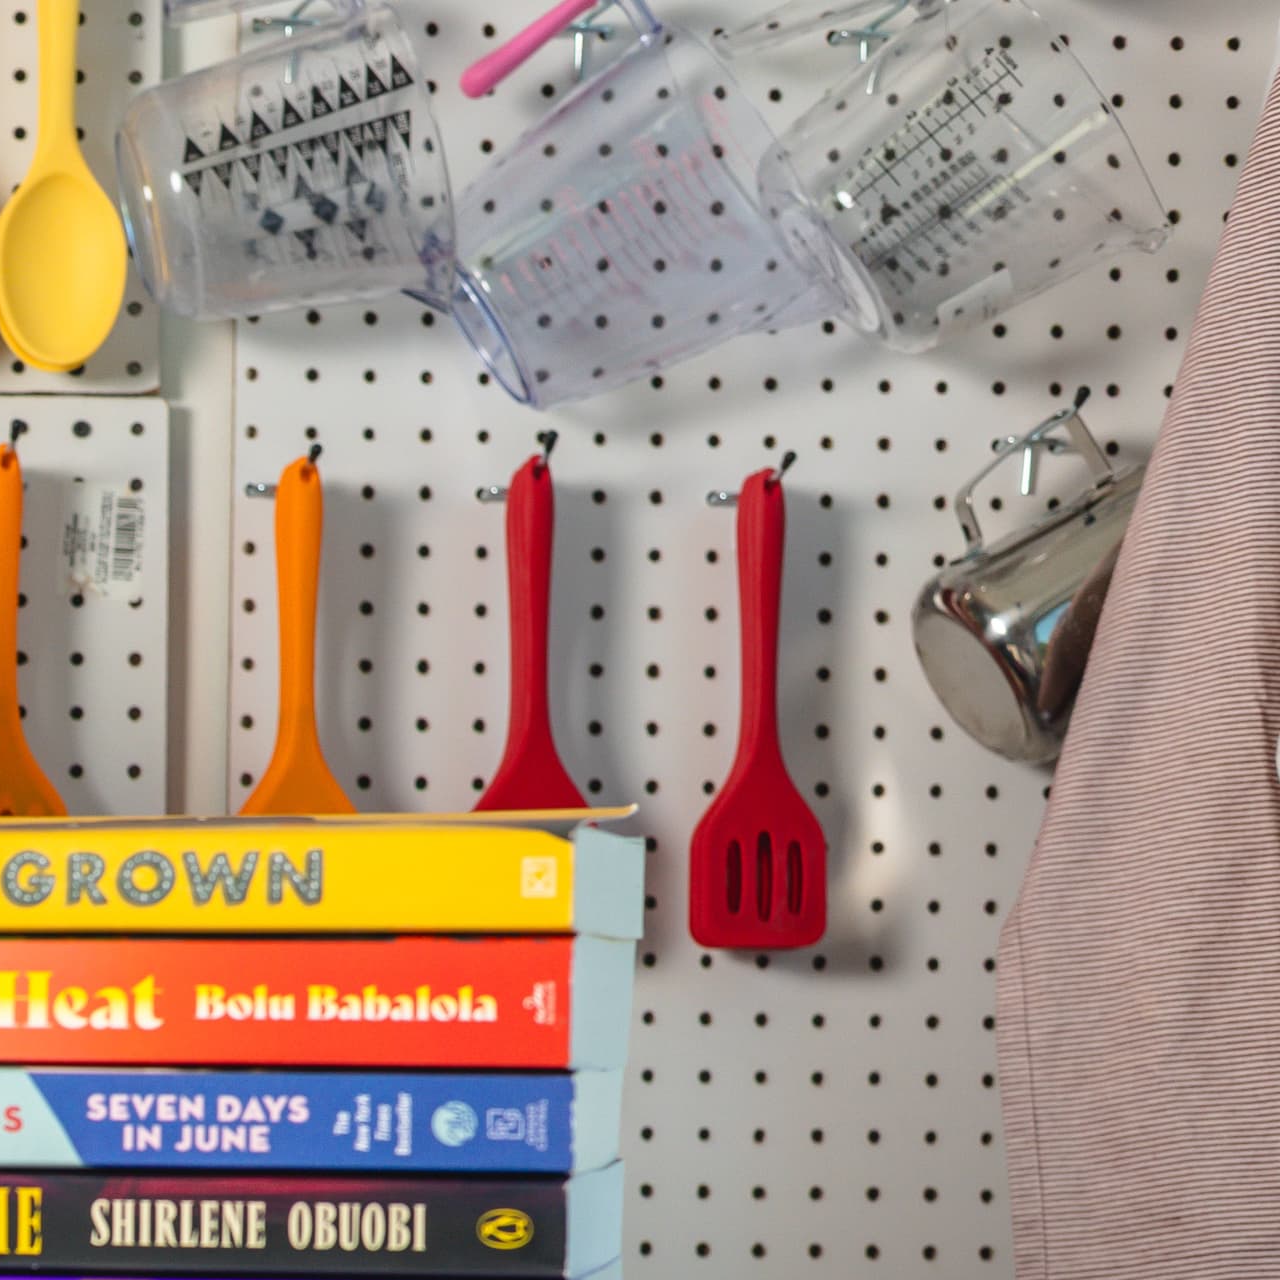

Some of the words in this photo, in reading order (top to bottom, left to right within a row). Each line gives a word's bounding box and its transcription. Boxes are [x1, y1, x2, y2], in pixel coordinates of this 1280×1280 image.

[0, 849, 323, 908] GROWN
[194, 984, 295, 1020] Bolu
[307, 985, 498, 1022] Babalola
[87, 1094, 205, 1121] SEVEN
[217, 1096, 309, 1122] DAYS
[123, 1124, 161, 1152] IN
[175, 1126, 270, 1152] JUNE
[91, 1199, 266, 1248] SHIRLENE
[288, 1201, 427, 1251] OBUOBI
